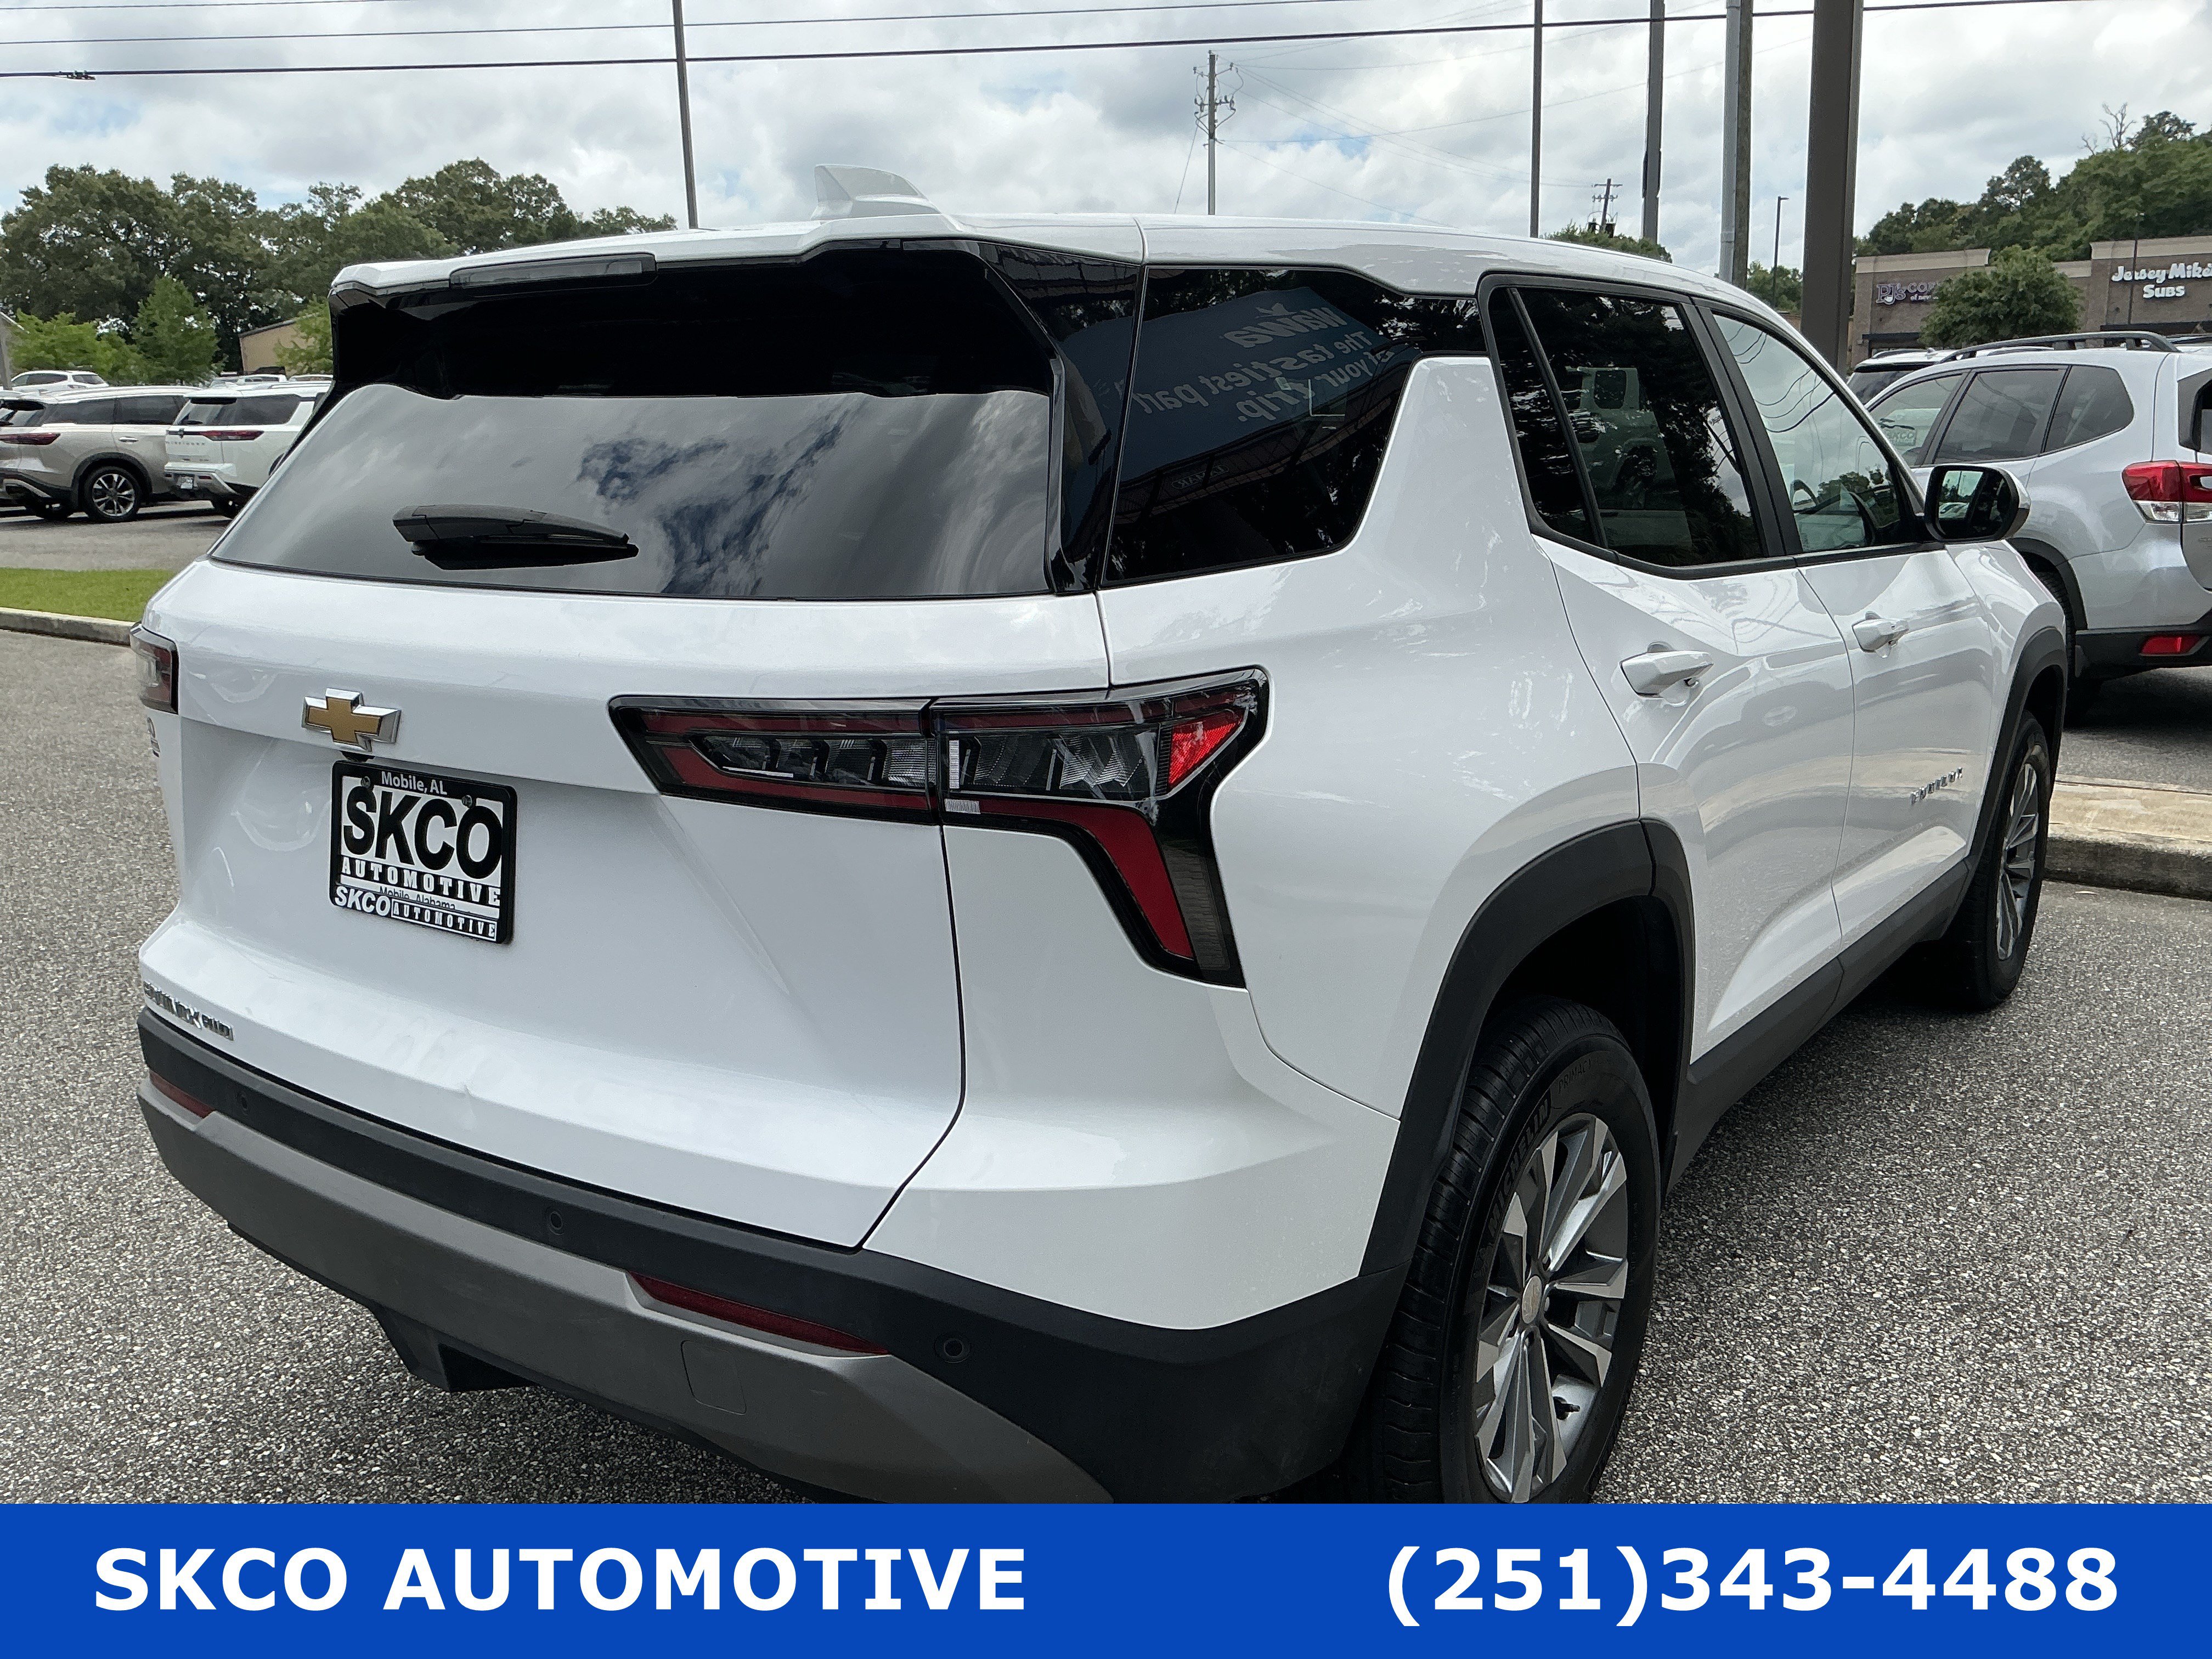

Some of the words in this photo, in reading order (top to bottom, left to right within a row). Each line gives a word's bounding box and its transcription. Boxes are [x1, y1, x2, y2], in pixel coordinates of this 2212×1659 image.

[2168, 262, 2212, 279] Mike
[381, 771, 427, 794] Mobile,
[430, 780, 448, 795] AL
[343, 786, 503, 879] SKCO
[342, 857, 501, 907] AUTOMOTIVE
[334, 885, 391, 917] SKCO
[393, 902, 496, 938] AUTOMOTIVE
